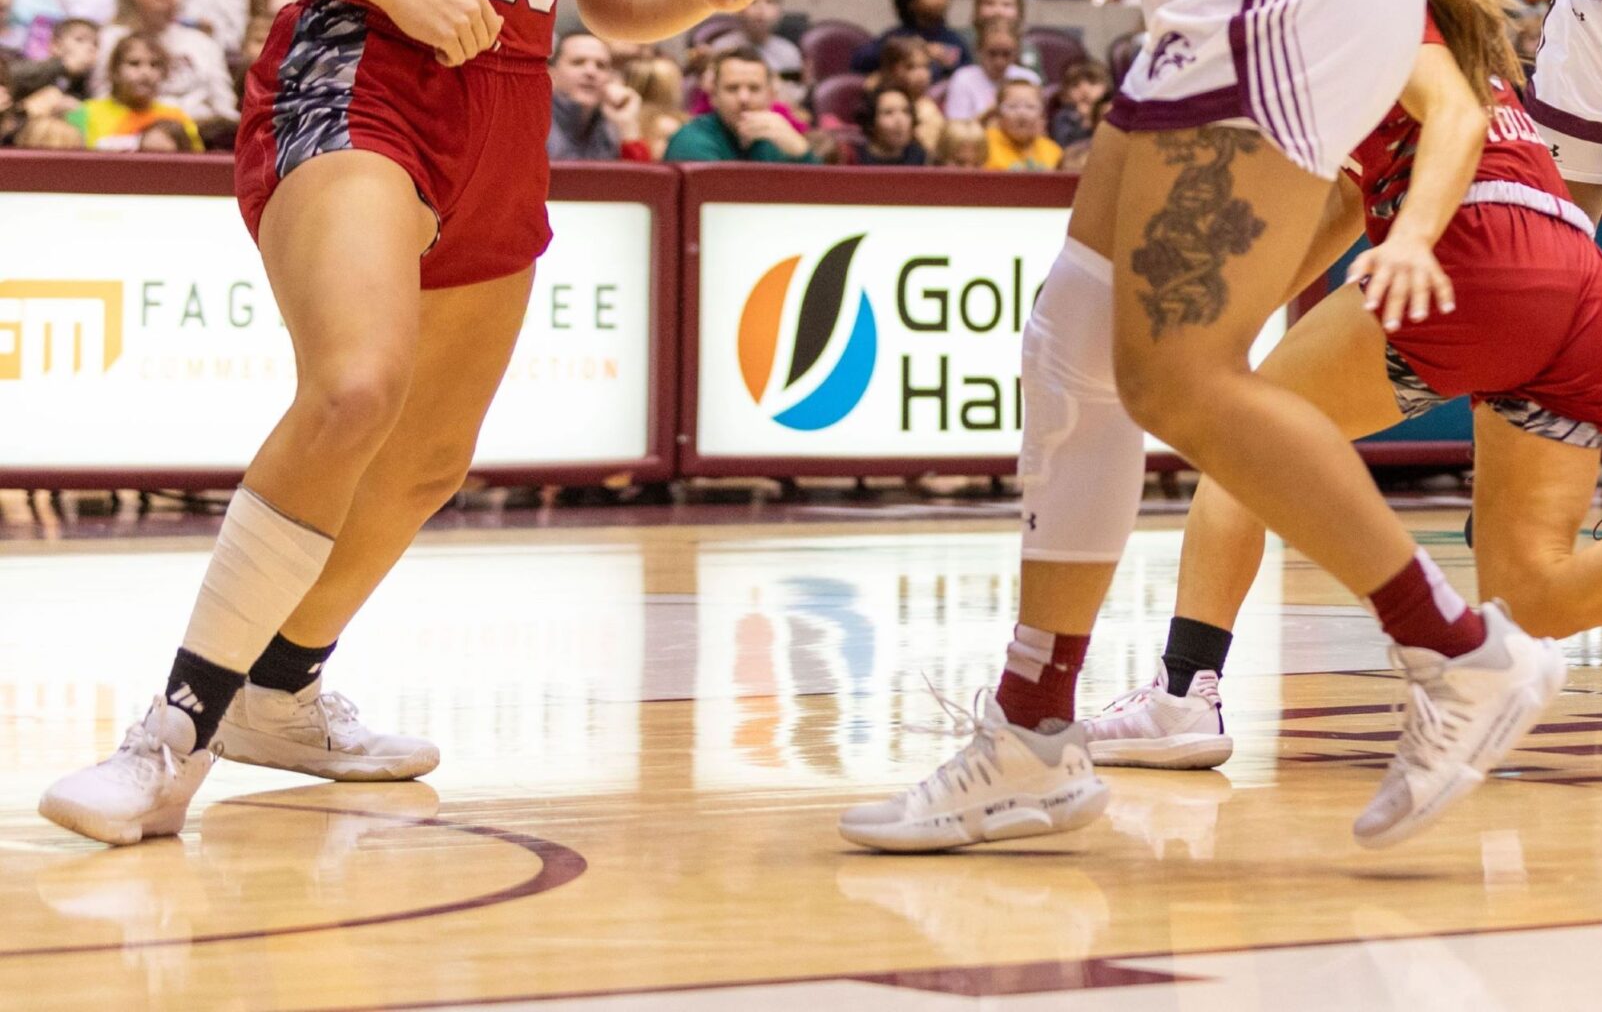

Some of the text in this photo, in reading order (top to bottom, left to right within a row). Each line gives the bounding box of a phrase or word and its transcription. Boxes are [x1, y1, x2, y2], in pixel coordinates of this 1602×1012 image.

[140, 280, 618, 330] FAG EE
[897, 256, 1046, 333] Gol
